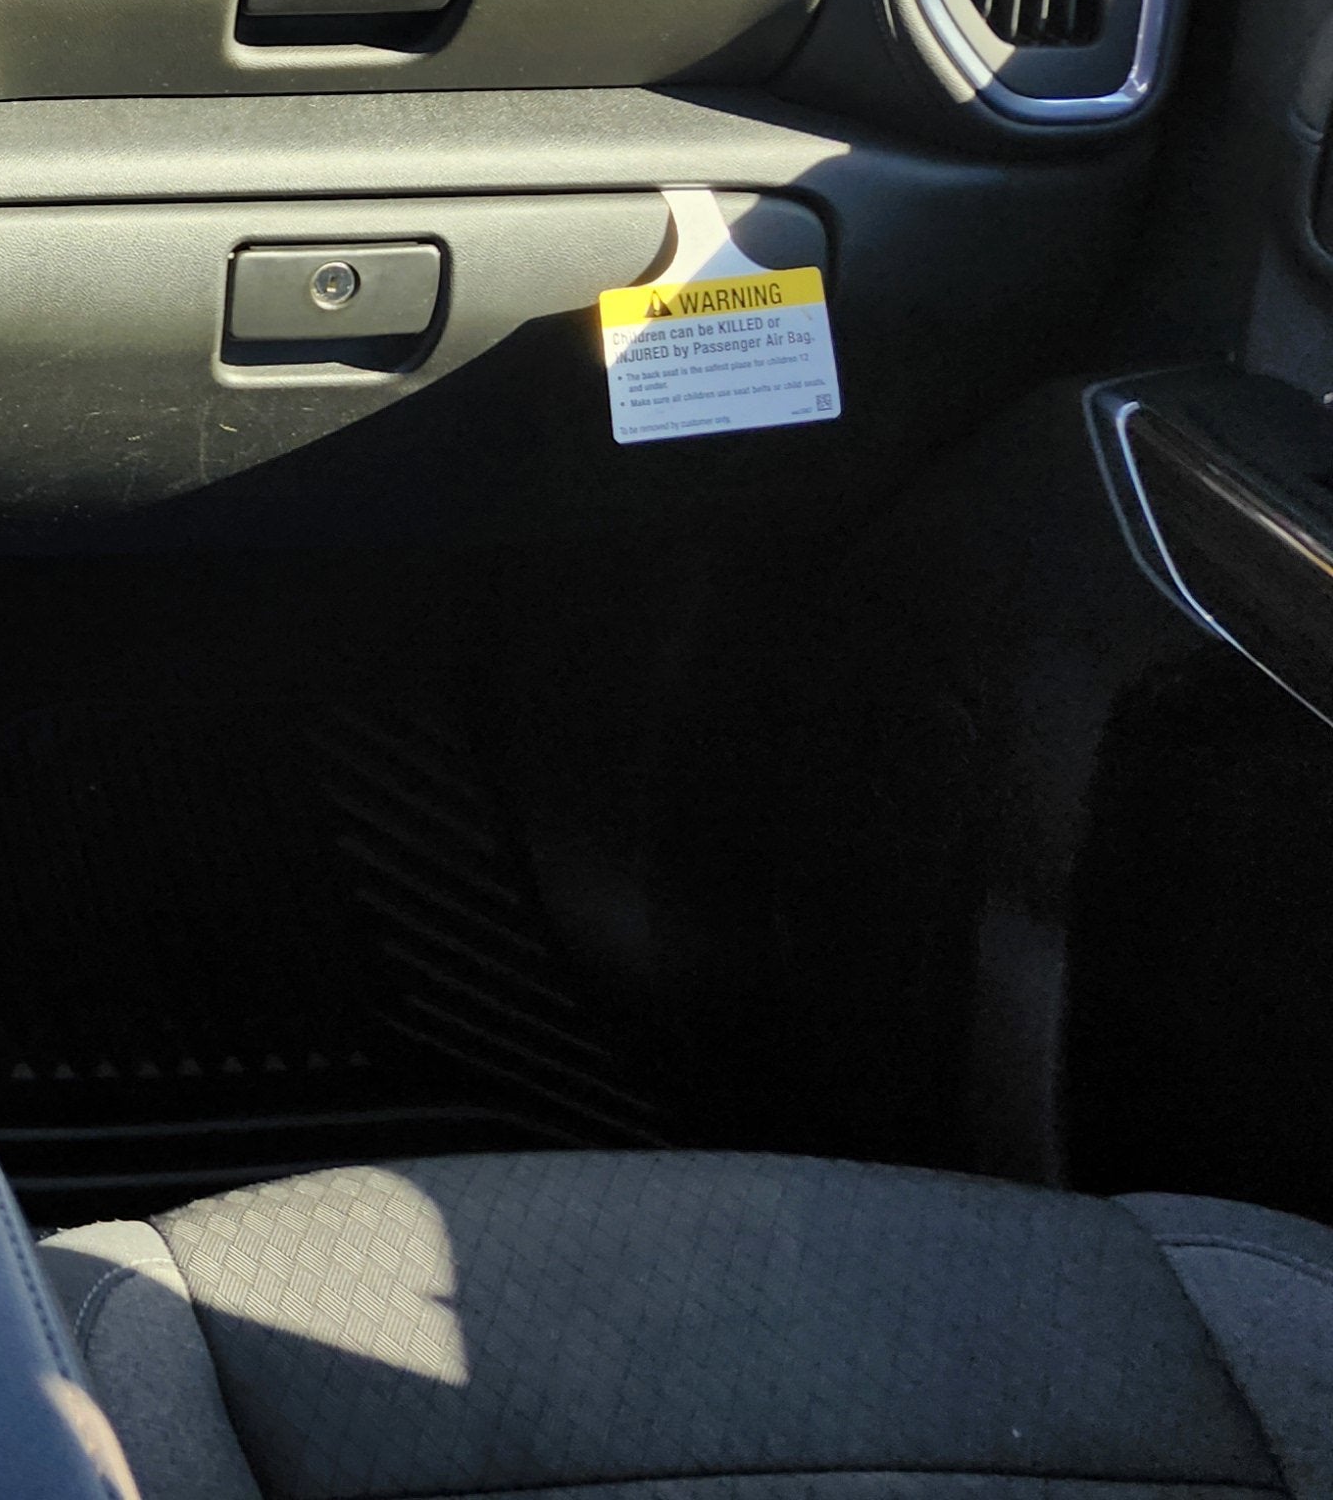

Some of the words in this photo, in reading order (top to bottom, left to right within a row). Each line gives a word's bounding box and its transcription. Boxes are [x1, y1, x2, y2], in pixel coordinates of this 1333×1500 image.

[678, 283, 782, 314] WARNING
[613, 328, 666, 345] Children
[670, 327, 693, 339] can
[698, 324, 713, 336] be
[717, 317, 763, 334] KILLED
[767, 317, 780, 329] or
[614, 345, 669, 364] INJURED
[673, 344, 689, 359] by
[694, 338, 761, 355] Passenger
[766, 334, 783, 347] Air
[787, 331, 815, 345] Bag.
